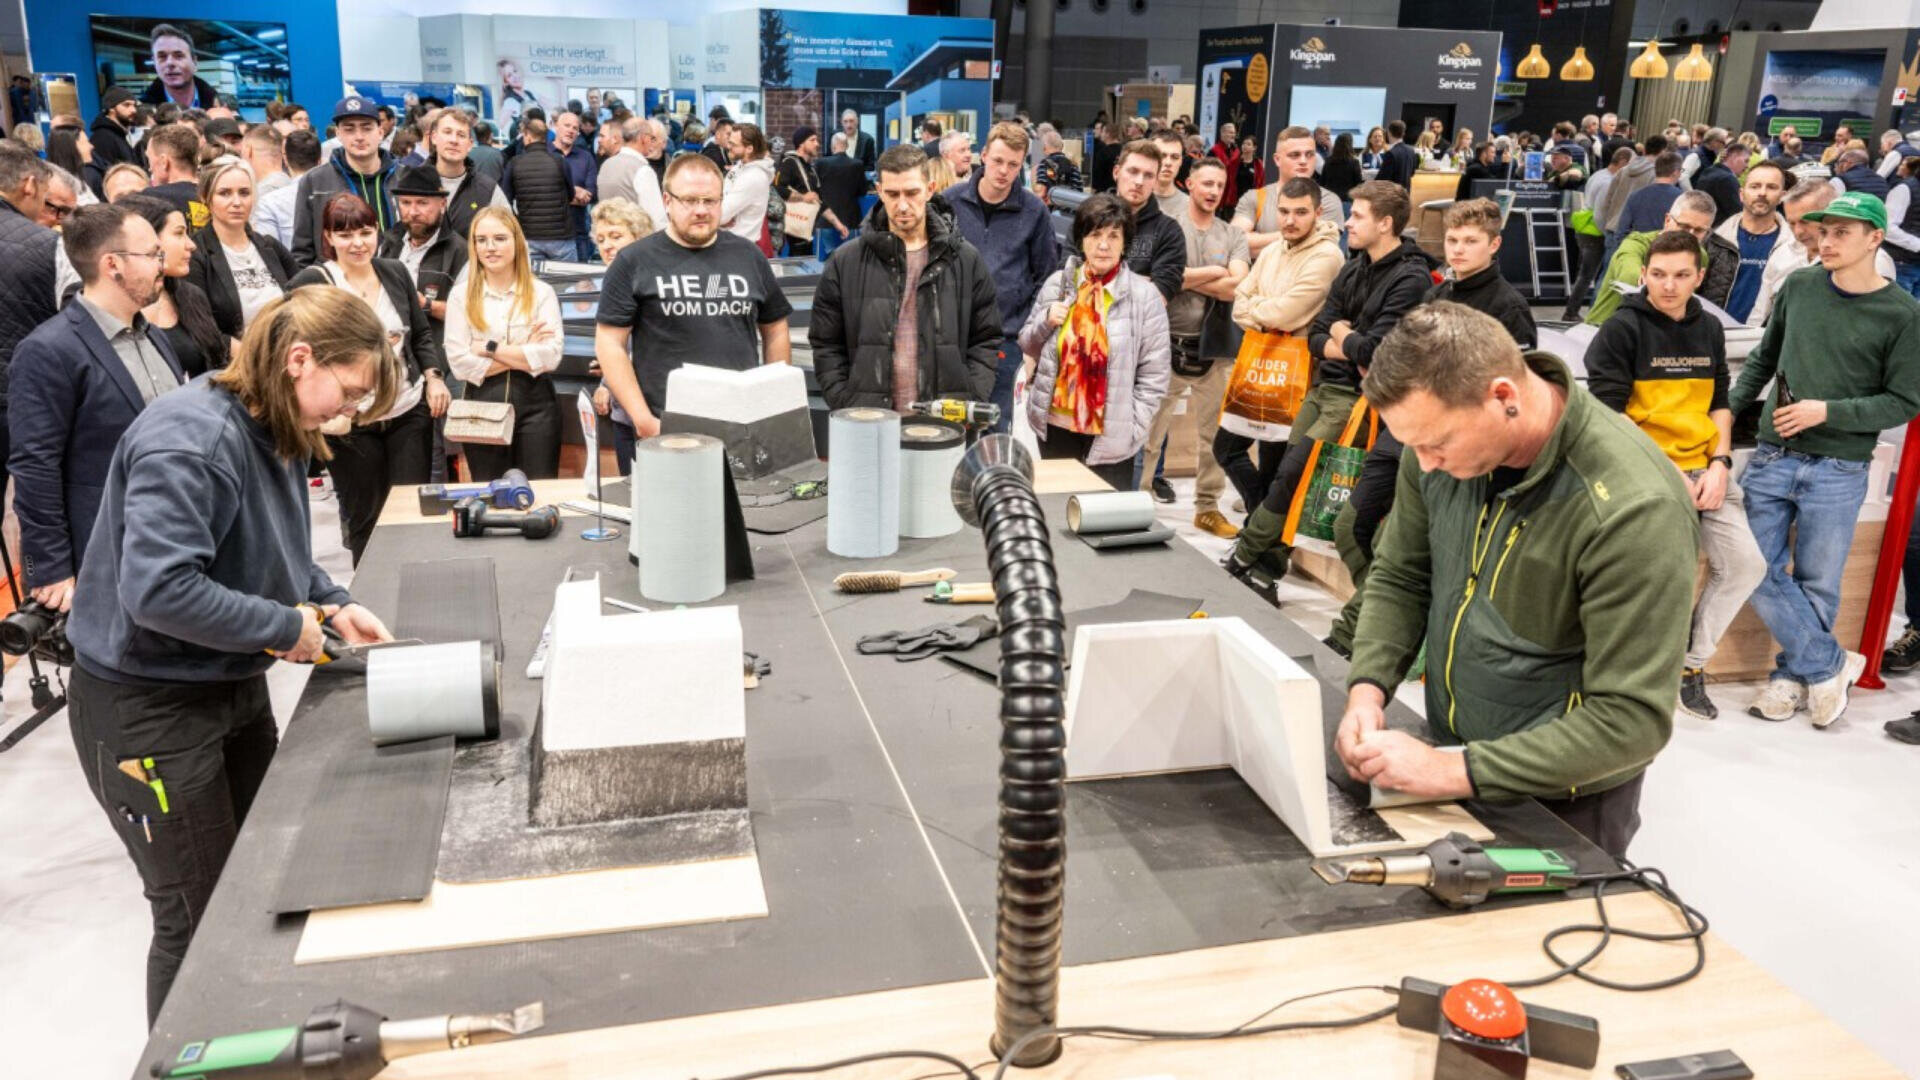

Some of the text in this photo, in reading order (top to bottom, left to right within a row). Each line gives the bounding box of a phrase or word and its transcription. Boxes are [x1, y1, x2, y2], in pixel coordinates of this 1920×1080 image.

[528, 44, 608, 62] Leicht verlegt.
[1289, 49, 1336, 64] Kingspan
[530, 61, 565, 73] Clever
[1437, 54, 1482, 69] Kingspan
[1437, 77, 1477, 90] Services
[661, 300, 752, 317] VOM DACH
[1245, 369, 1286, 388] OLAR
[1328, 486, 1351, 502] GR
